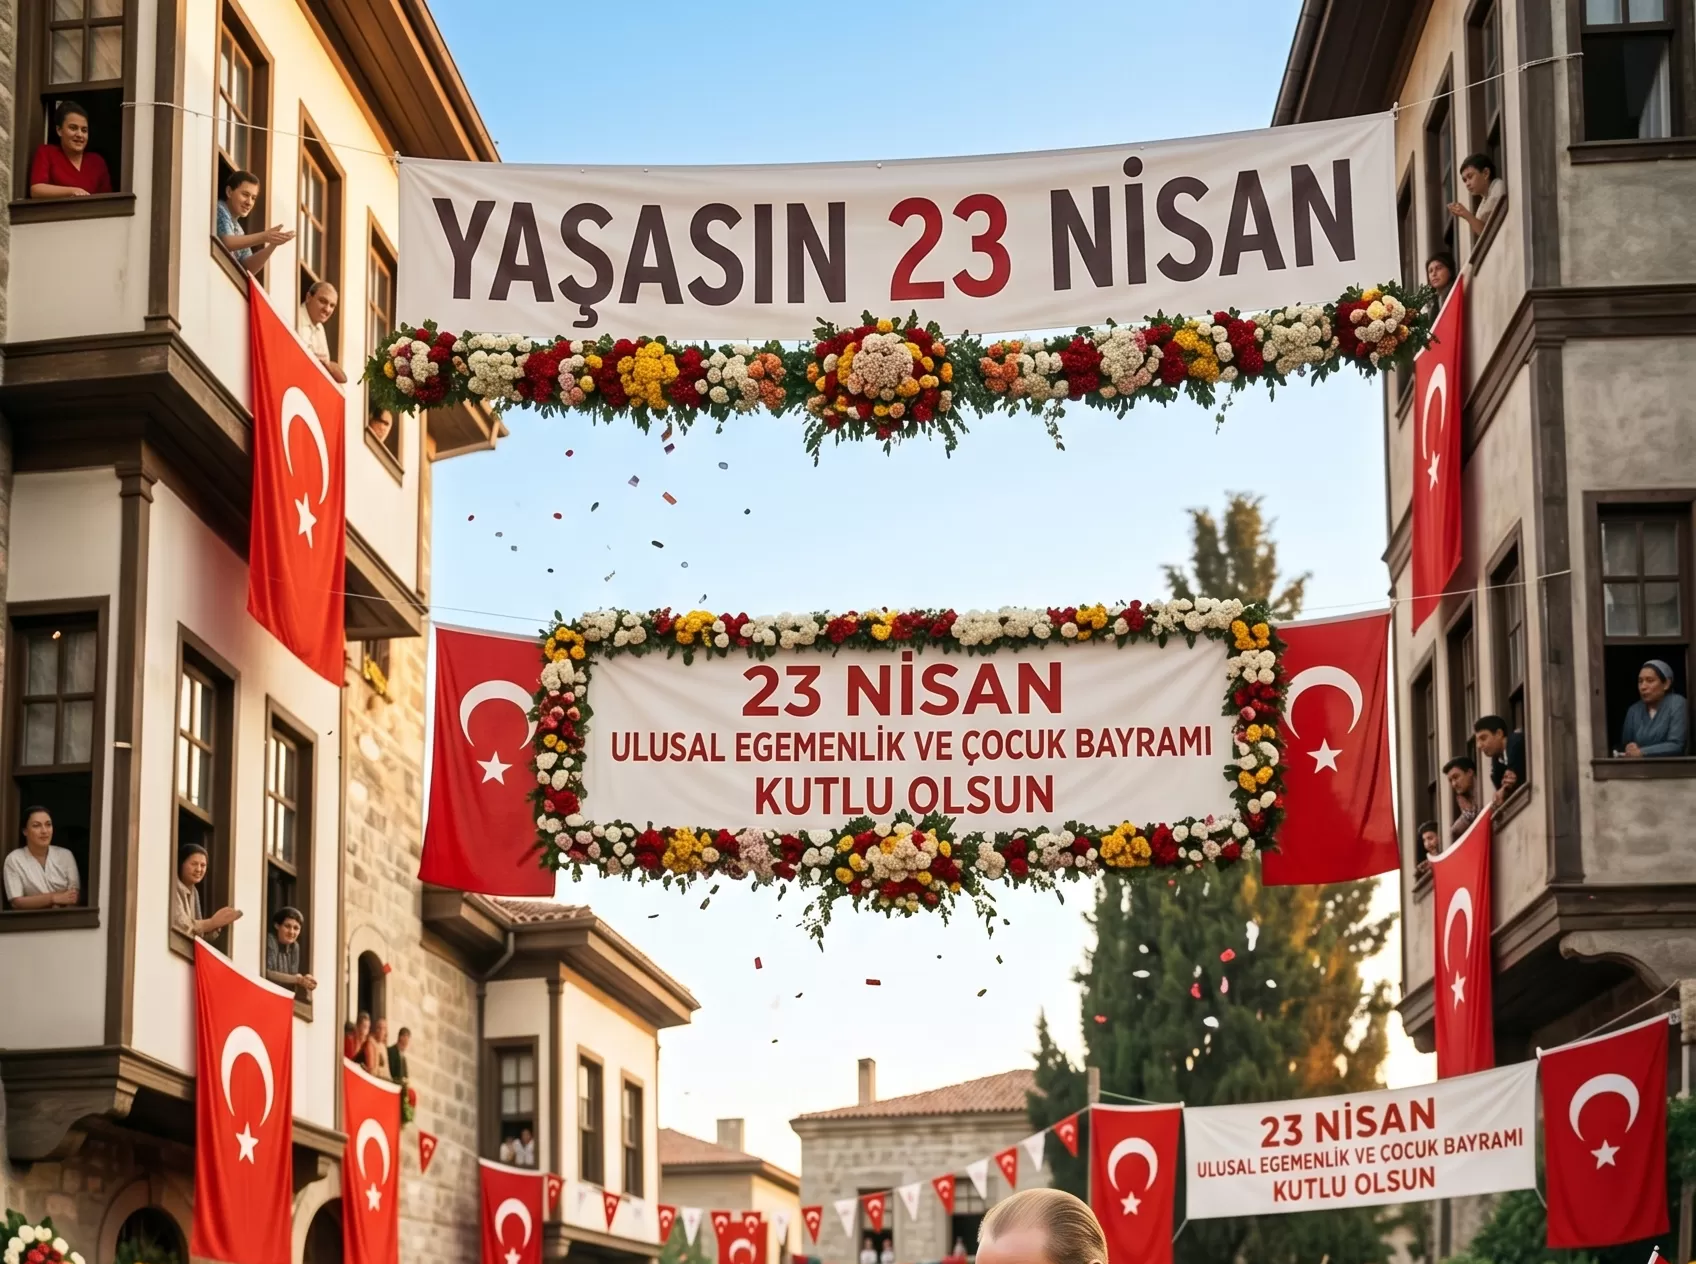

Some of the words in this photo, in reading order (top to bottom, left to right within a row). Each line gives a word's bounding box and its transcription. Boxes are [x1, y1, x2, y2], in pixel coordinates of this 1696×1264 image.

[432, 198, 846, 328] YAŞASIN
[889, 194, 1011, 301] 23
[1051, 157, 1355, 291] NİSAN
[742, 664, 821, 717] 23
[847, 650, 1062, 717] NİSAN
[611, 731, 726, 762] ULUSAL
[735, 724, 906, 762] EGEMENLİK
[913, 730, 953, 761] VE
[961, 729, 1067, 767] ÇOCUK
[1076, 726, 1213, 759] BAYRAMI
[755, 776, 893, 816] KUTLU
[908, 775, 1054, 815] OLSUN
[1260, 1114, 1304, 1149] 23
[1315, 1097, 1436, 1144] NİSAN
[1197, 1158, 1257, 1178] ULUSAL
[1260, 1146, 1350, 1174] EGEMENLİK
[1354, 1146, 1376, 1164] VE
[1380, 1139, 1439, 1163] ÇOCUK
[1443, 1127, 1523, 1155] BAYRAMI
[1273, 1175, 1346, 1202] KUTLU
[1354, 1166, 1435, 1196] OLSUN
